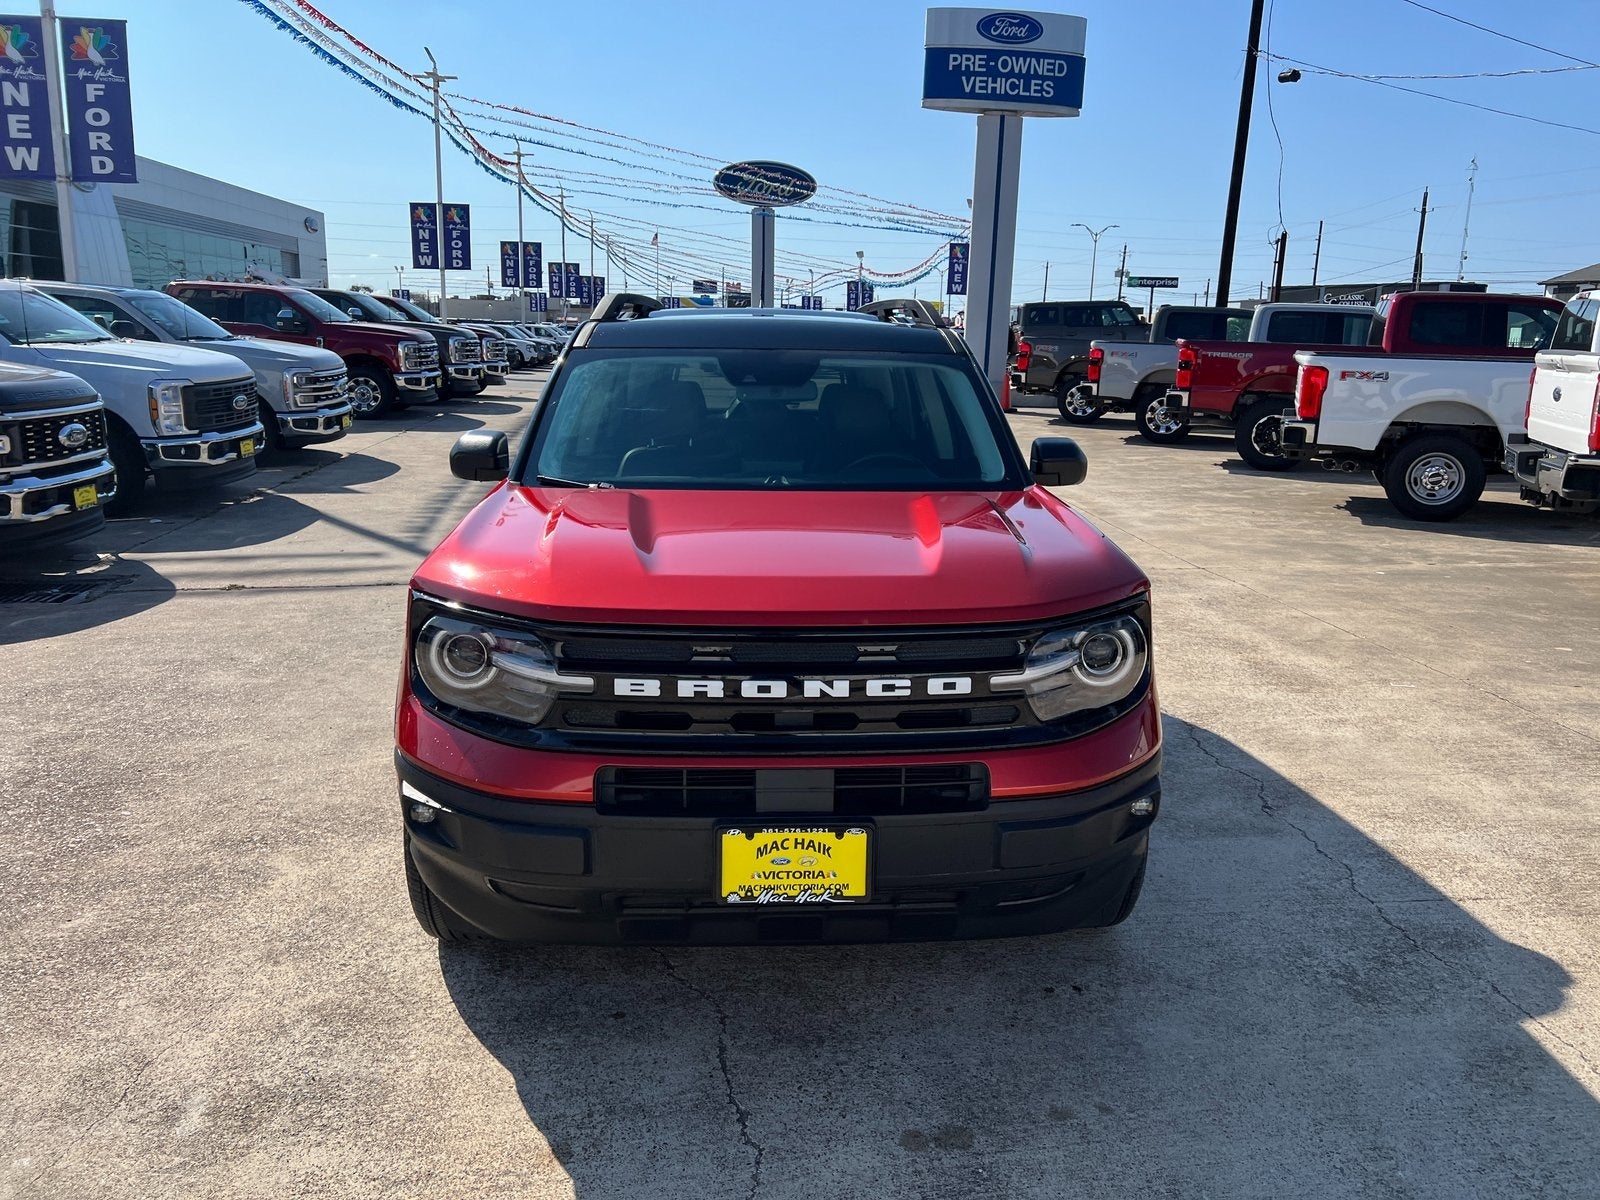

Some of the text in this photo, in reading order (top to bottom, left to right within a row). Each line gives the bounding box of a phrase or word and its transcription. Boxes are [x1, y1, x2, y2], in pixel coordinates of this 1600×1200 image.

[990, 17, 1030, 38] Ford
[961, 76, 1055, 98] VEHICLES
[1, 81, 40, 171] NEW
[84, 83, 115, 175] FORD
[736, 169, 798, 197] Ford
[418, 229, 433, 266] NEW
[451, 230, 463, 268] FORD
[505, 259, 516, 286] NEW
[528, 260, 537, 287] FORD
[951, 263, 963, 293] NEW
[1132, 278, 1178, 287] enterprise
[552, 275, 560, 297] NEW
[569, 276, 577, 297] FORD
[1110, 350, 1138, 359] FX4
[1205, 351, 1254, 359] TREMOR
[1340, 370, 1390, 382] FX4
[613, 676, 973, 698] BRONCO
[755, 837, 833, 860] MAC HAIK
[771, 857, 790, 866] Ford
[762, 870, 827, 880] VICTORIA
[755, 889, 838, 904] Mac Haik
